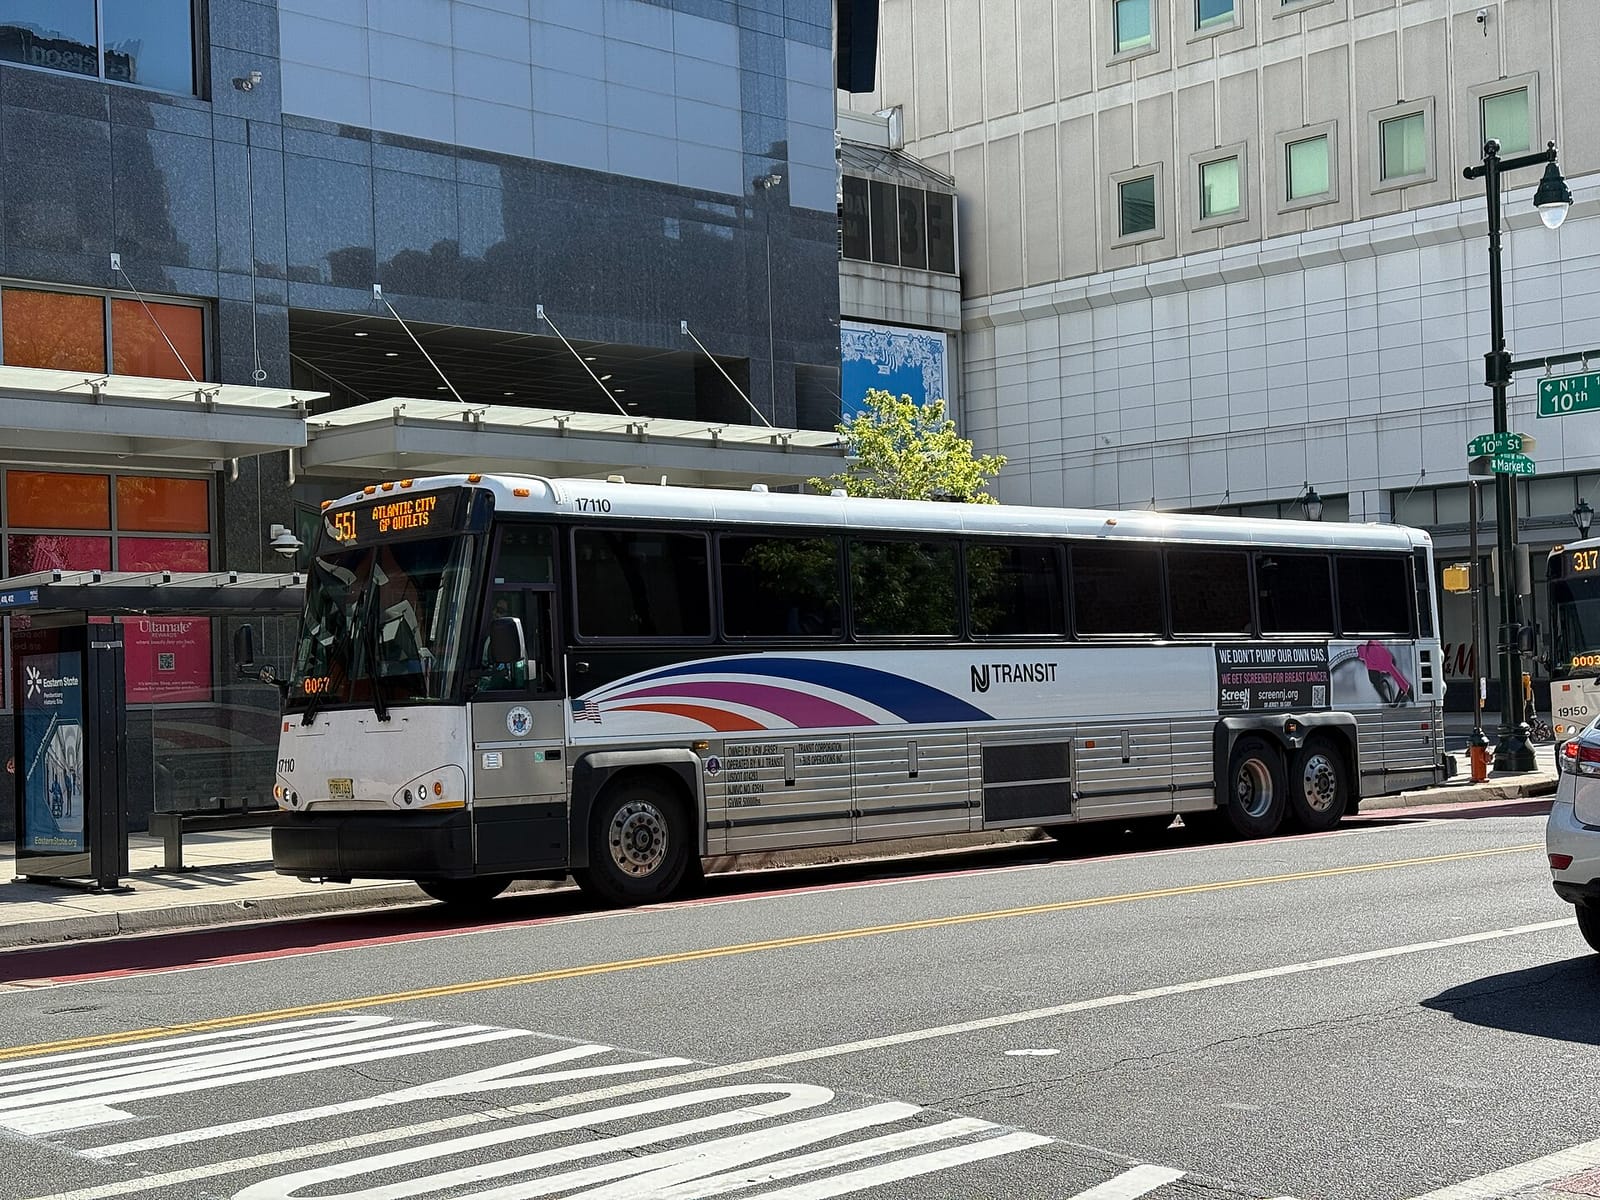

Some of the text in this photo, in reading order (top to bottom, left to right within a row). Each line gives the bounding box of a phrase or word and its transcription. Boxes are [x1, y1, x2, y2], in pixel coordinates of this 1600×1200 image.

[1551, 390, 1588, 412] 10th
[1481, 439, 1520, 453] 10th St
[1497, 459, 1535, 473] Market St
[372, 496, 437, 520] ATLANTIC CITY
[575, 497, 611, 513] 17110
[335, 510, 357, 541] 551
[392, 511, 430, 530] OUTLETS
[1573, 551, 1599, 571] 317
[139, 620, 191, 634] Ultamate
[1219, 648, 1327, 663] WE DON'T PUMP OUR OWN GAS.
[1572, 655, 1600, 667] 0003
[43, 676, 79, 688] Eastern State
[970, 663, 1058, 693] NJ TRANSIT
[1221, 673, 1231, 685] WE
[1231, 673, 1243, 684] GET
[1243, 672, 1272, 684] SCREENED
[1273, 672, 1285, 683] FOR
[1285, 671, 1305, 683] BREAST
[1258, 688, 1299, 701] screennj.org
[1558, 706, 1588, 717] 19150
[727, 745, 743, 757] OWNED
[744, 745, 751, 756] BY
[752, 745, 762, 755] NEW
[763, 744, 778, 754] JERSEY
[815, 742, 842, 752] CORPORATION
[278, 758, 295, 772] 17110
[726, 759, 749, 770] OPERATED
[749, 758, 755, 769] BY
[765, 756, 783, 768] TRANSIT
[34, 836, 77, 848] EasternState.org
